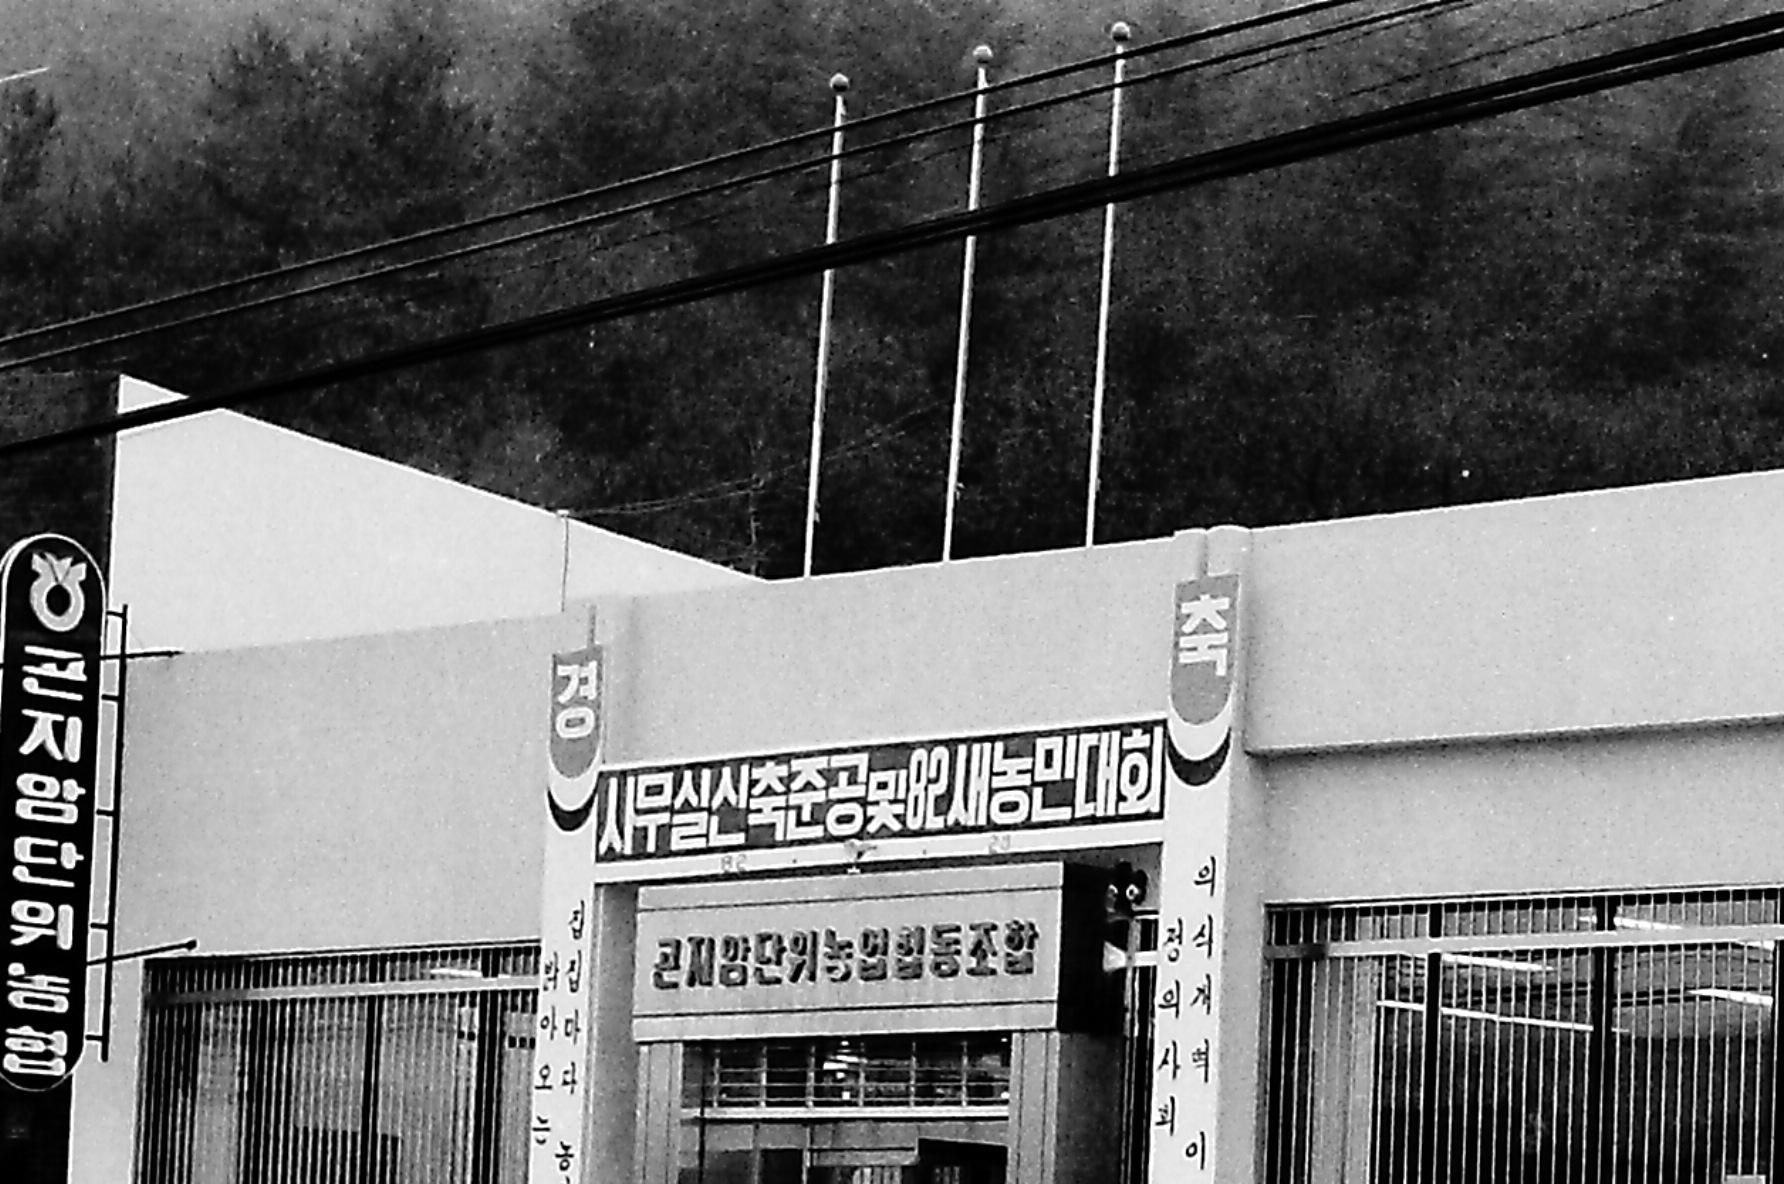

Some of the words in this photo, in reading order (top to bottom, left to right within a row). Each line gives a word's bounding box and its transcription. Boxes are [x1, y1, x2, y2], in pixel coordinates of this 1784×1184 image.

[1178, 594, 1230, 676] 축
[556, 662, 598, 739] 경
[3, 644, 88, 1077] 곤지암단위농협
